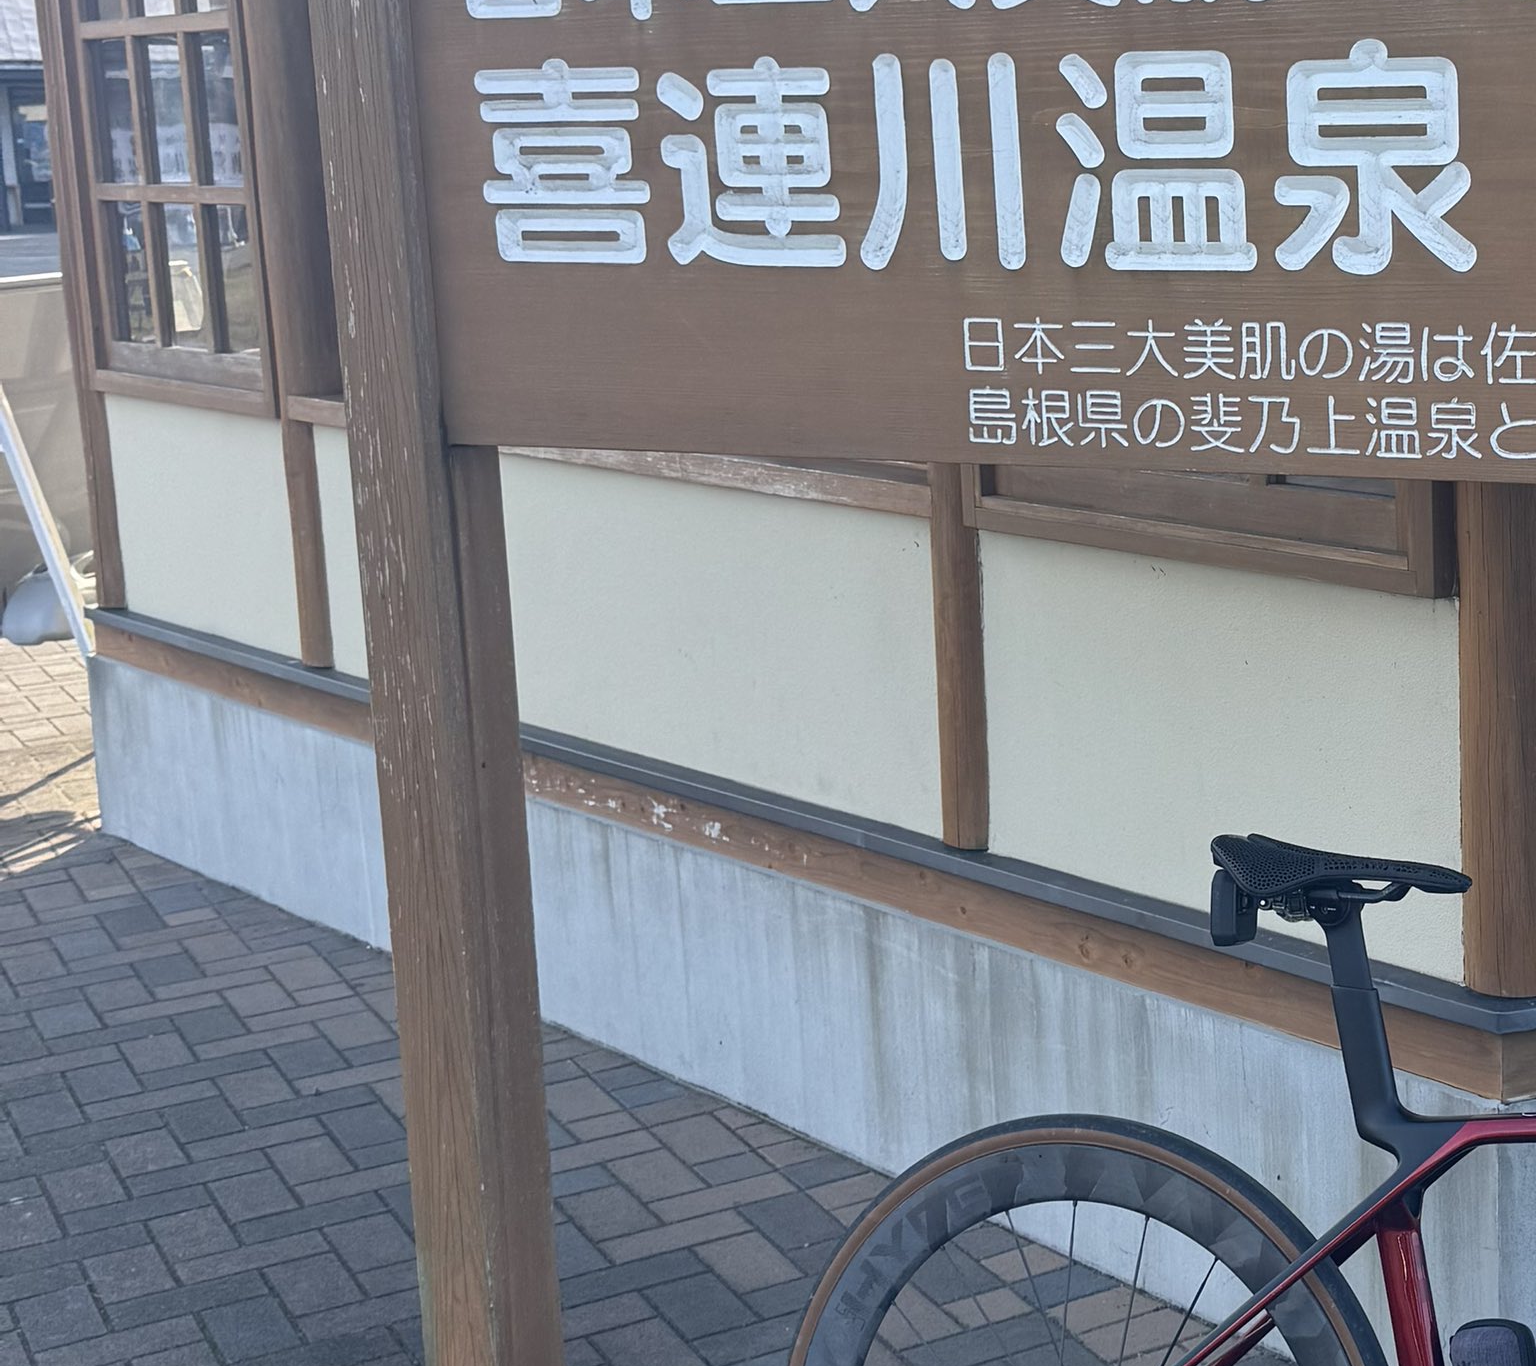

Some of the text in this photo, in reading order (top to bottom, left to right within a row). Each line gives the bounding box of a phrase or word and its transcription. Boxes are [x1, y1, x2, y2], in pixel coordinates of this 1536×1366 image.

[473, 38, 1479, 277] 喜連川温泉
